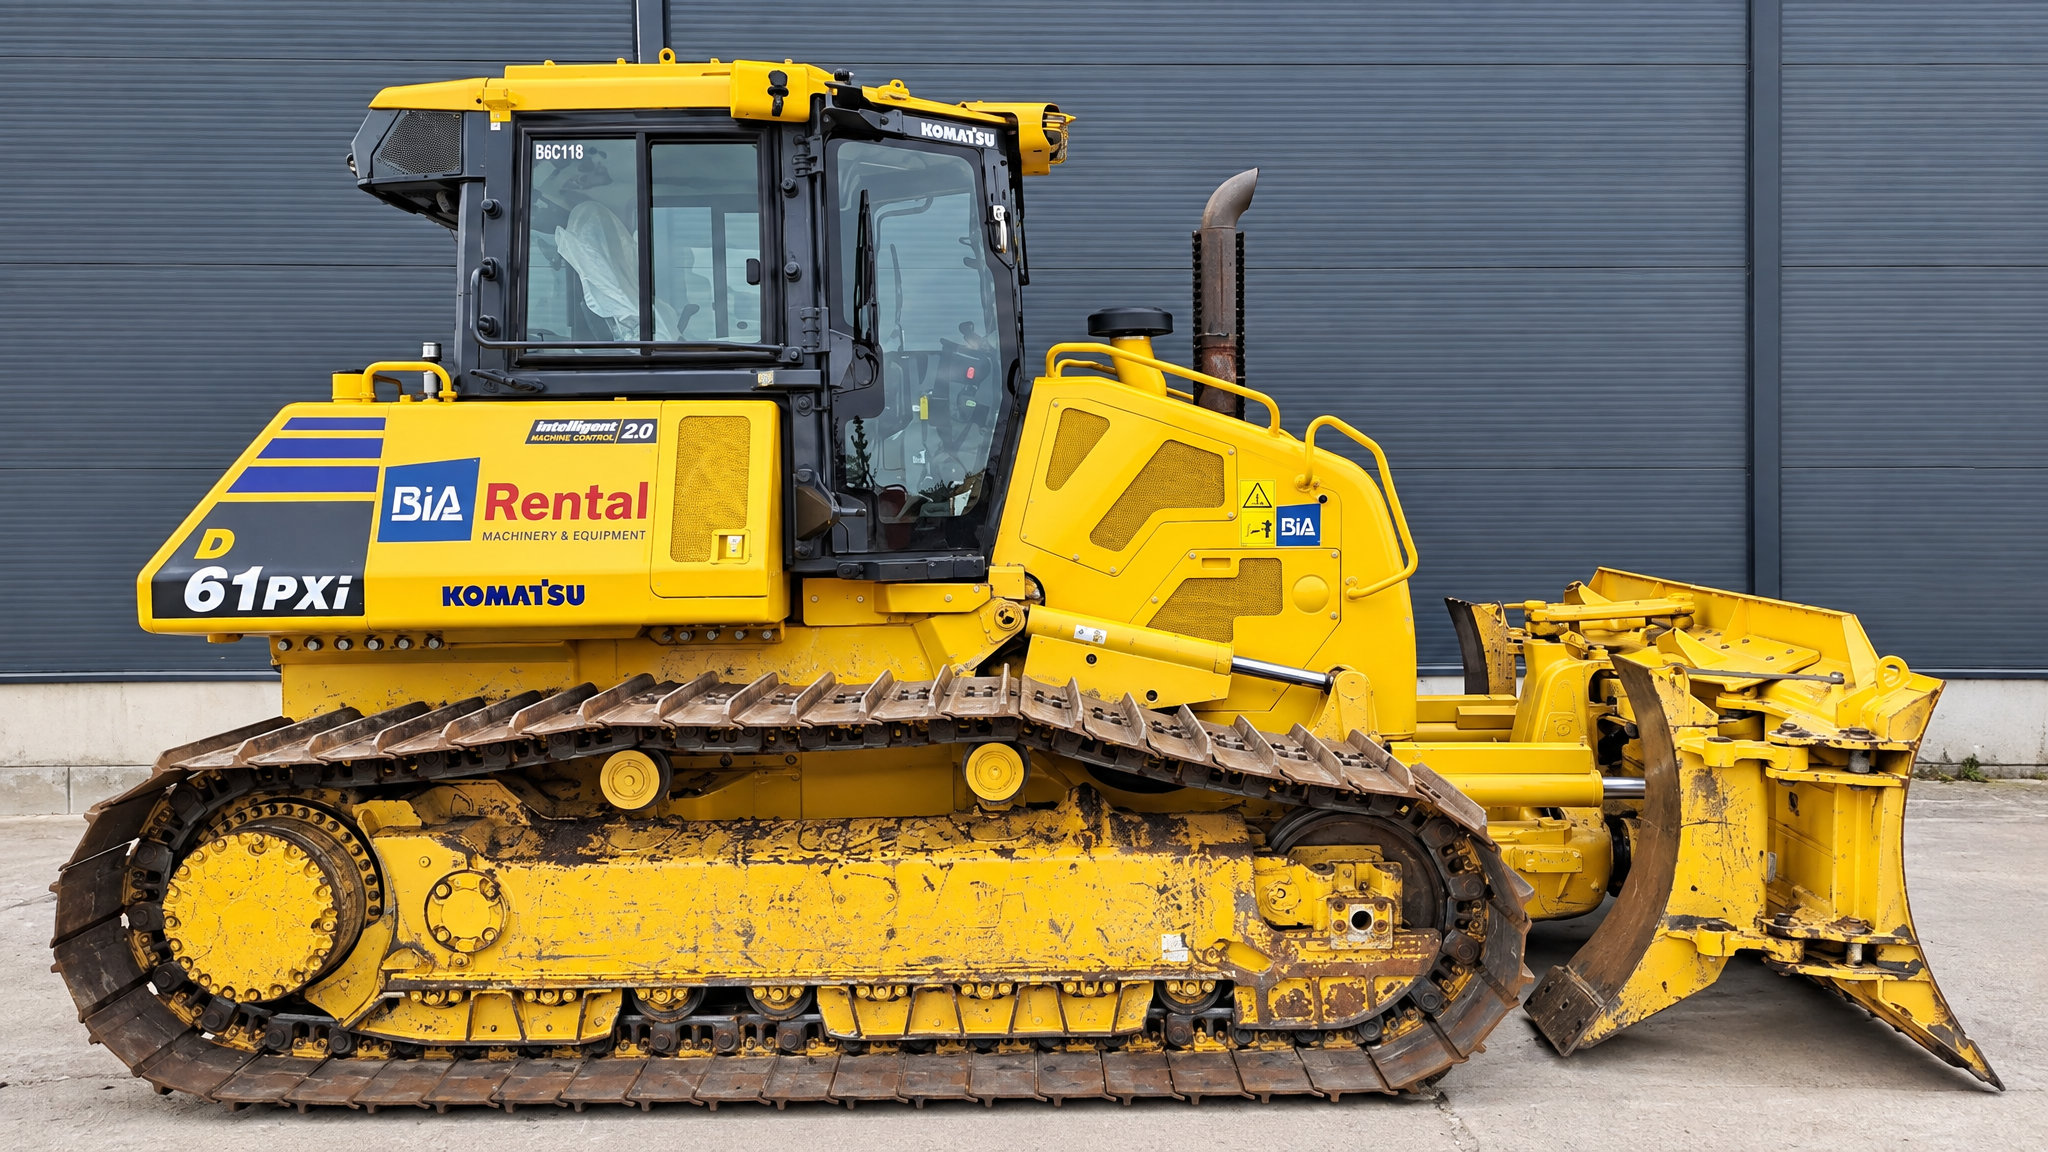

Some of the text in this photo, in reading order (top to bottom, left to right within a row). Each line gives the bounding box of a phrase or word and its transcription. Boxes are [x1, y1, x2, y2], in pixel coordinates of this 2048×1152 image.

[920, 122, 995, 147] KOMATSU
[535, 144, 584, 160] B6C118
[530, 434, 615, 442] MACHINE CONTROL
[621, 423, 654, 439] 2.0
[391, 485, 463, 522] BiA
[484, 481, 649, 521] Rental
[482, 530, 646, 542] MACHINERY & EQUIPMENT
[1281, 517, 1316, 536] BiA
[194, 528, 236, 560] D
[184, 566, 353, 613] 61PXi
[442, 579, 585, 607] KOMATSU
